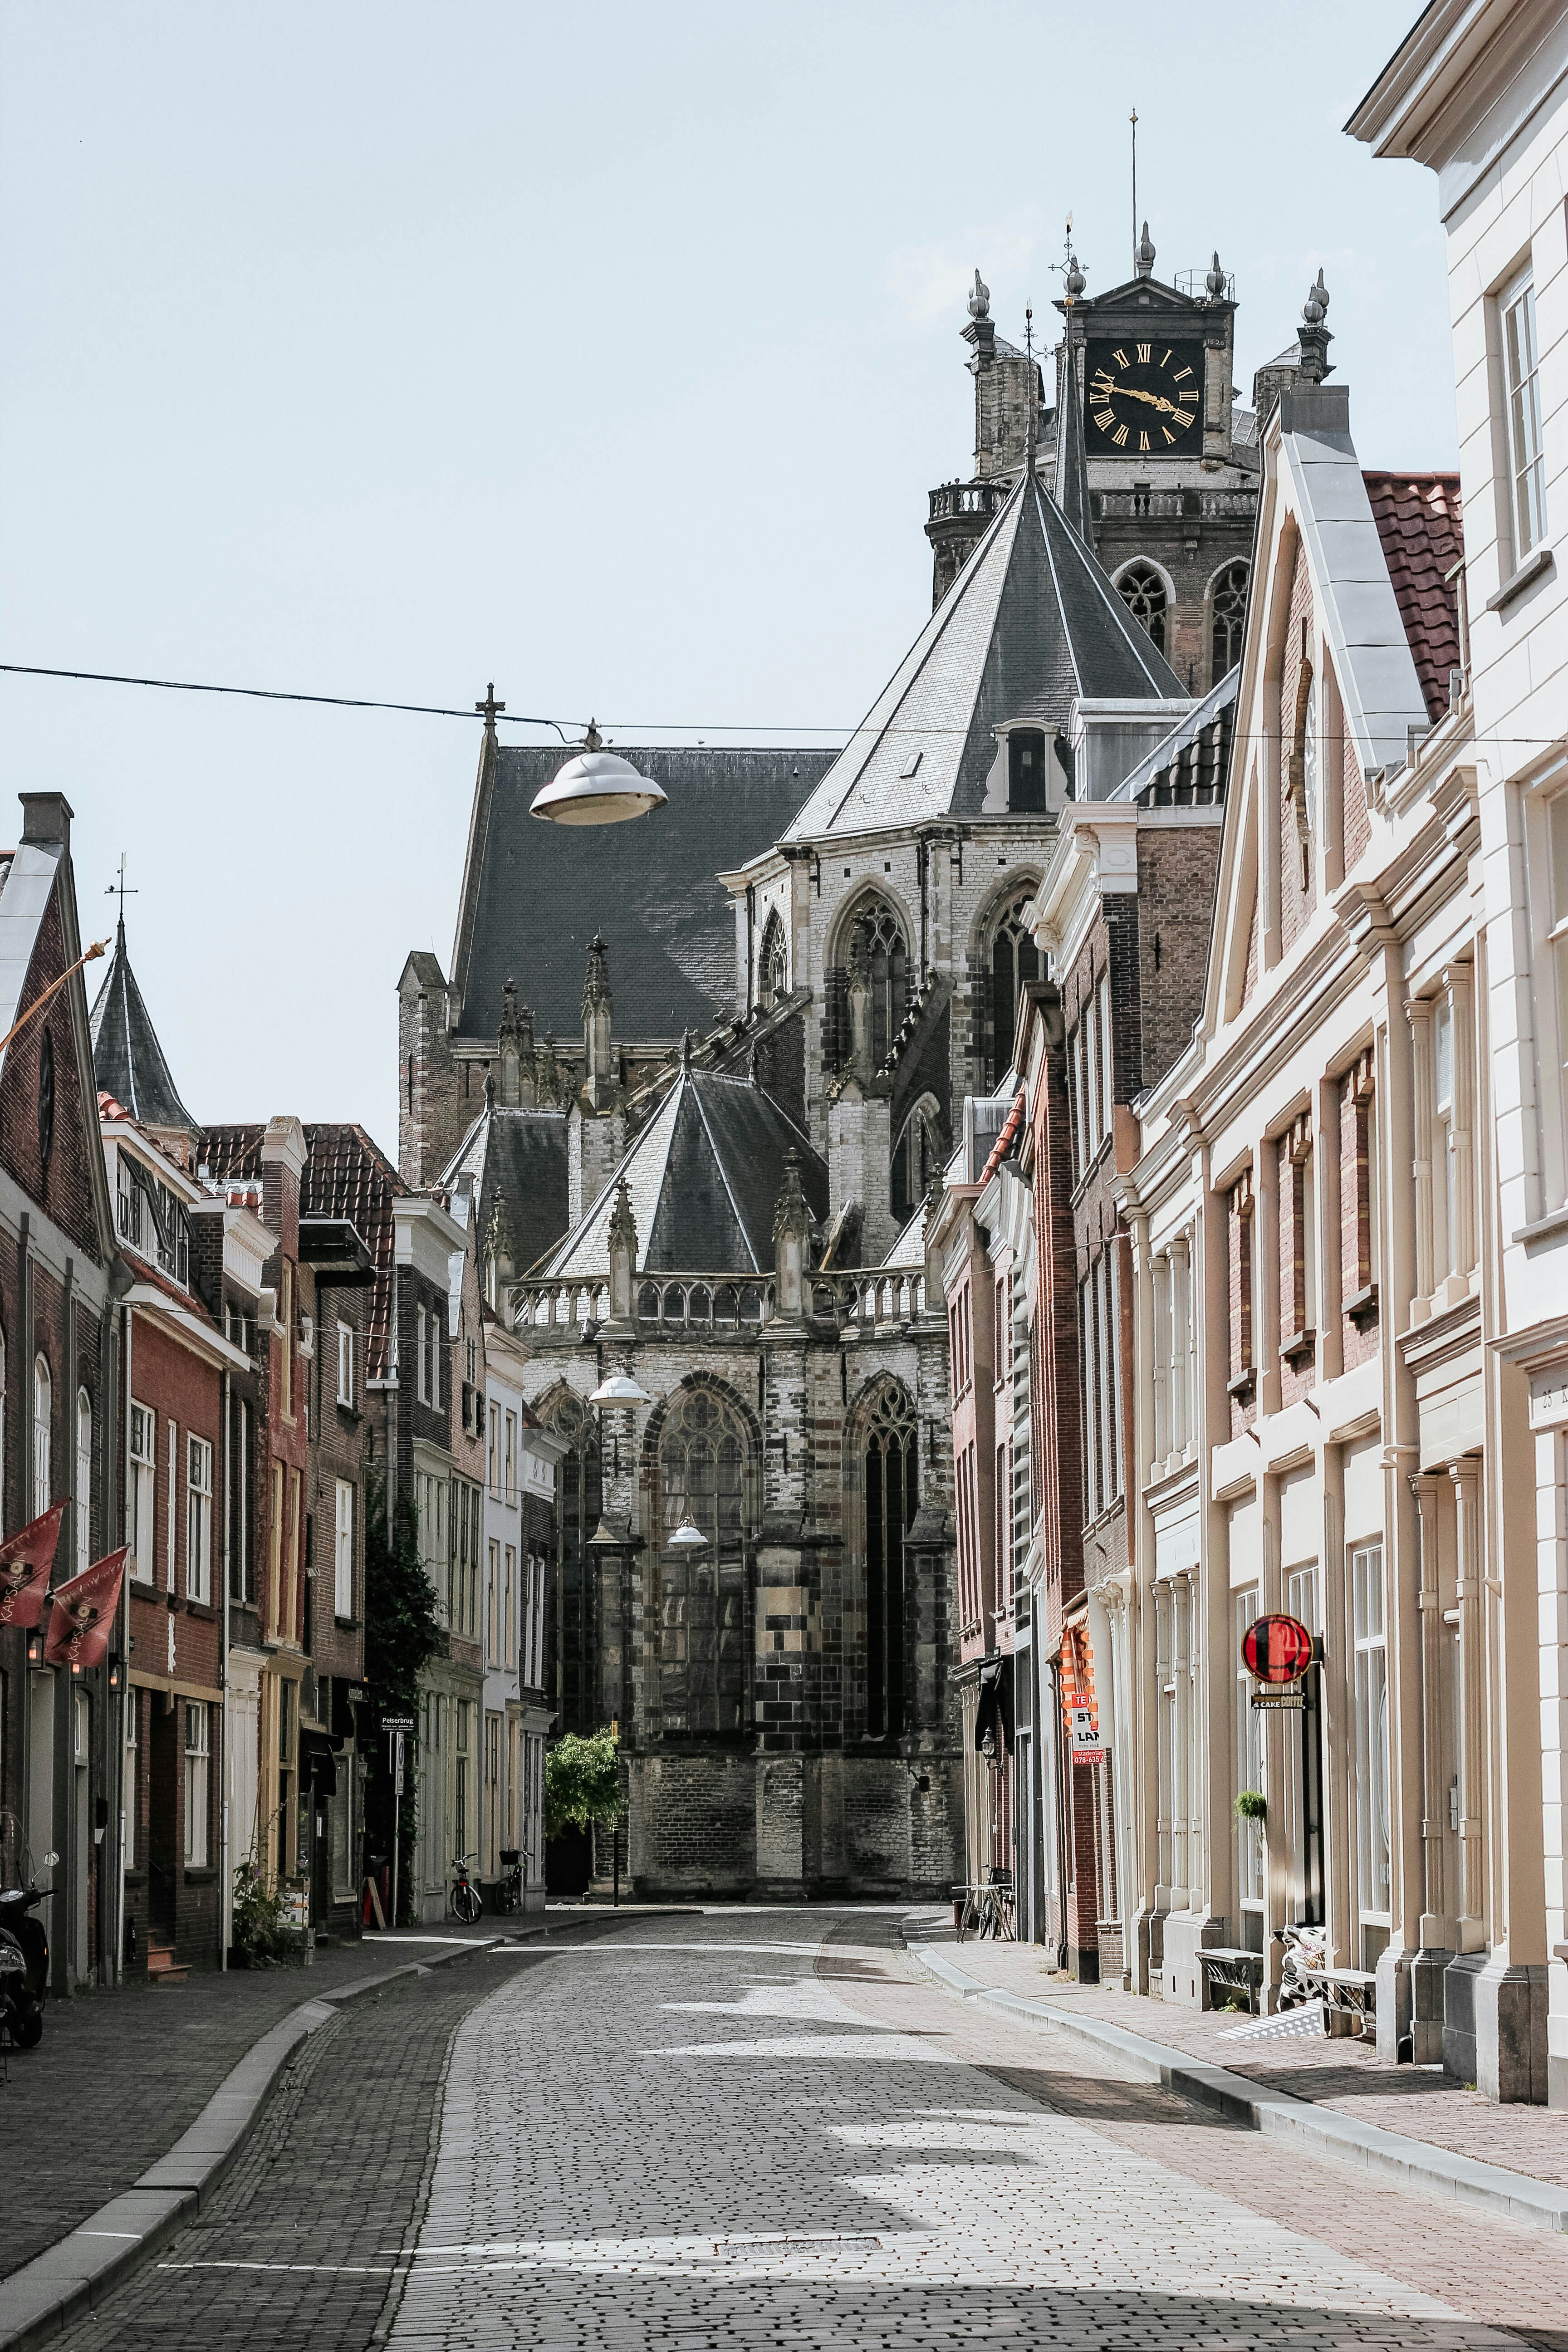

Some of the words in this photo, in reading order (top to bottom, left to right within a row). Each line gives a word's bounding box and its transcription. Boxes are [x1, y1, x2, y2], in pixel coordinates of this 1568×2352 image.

[1112, 349, 1131, 369] XI
[1137, 344, 1152, 363] XII
[1160, 349, 1172, 367] I
[1095, 368, 1115, 382] X
[1173, 366, 1193, 382] II
[1090, 392, 1109, 404] IX
[1179, 390, 1199, 402] III
[1093, 408, 1116, 431] VIII
[1171, 408, 1196, 428] IIII
[1112, 424, 1129, 446] VII
[1139, 431, 1151, 450] VI
[1162, 426, 1176, 444] V
[0, 1551, 27, 1621] KAPSALON
[68, 1596, 93, 1661] KAPSALON
[1075, 1696, 1086, 1704] TE
[1280, 1696, 1303, 1707] COFFEE
